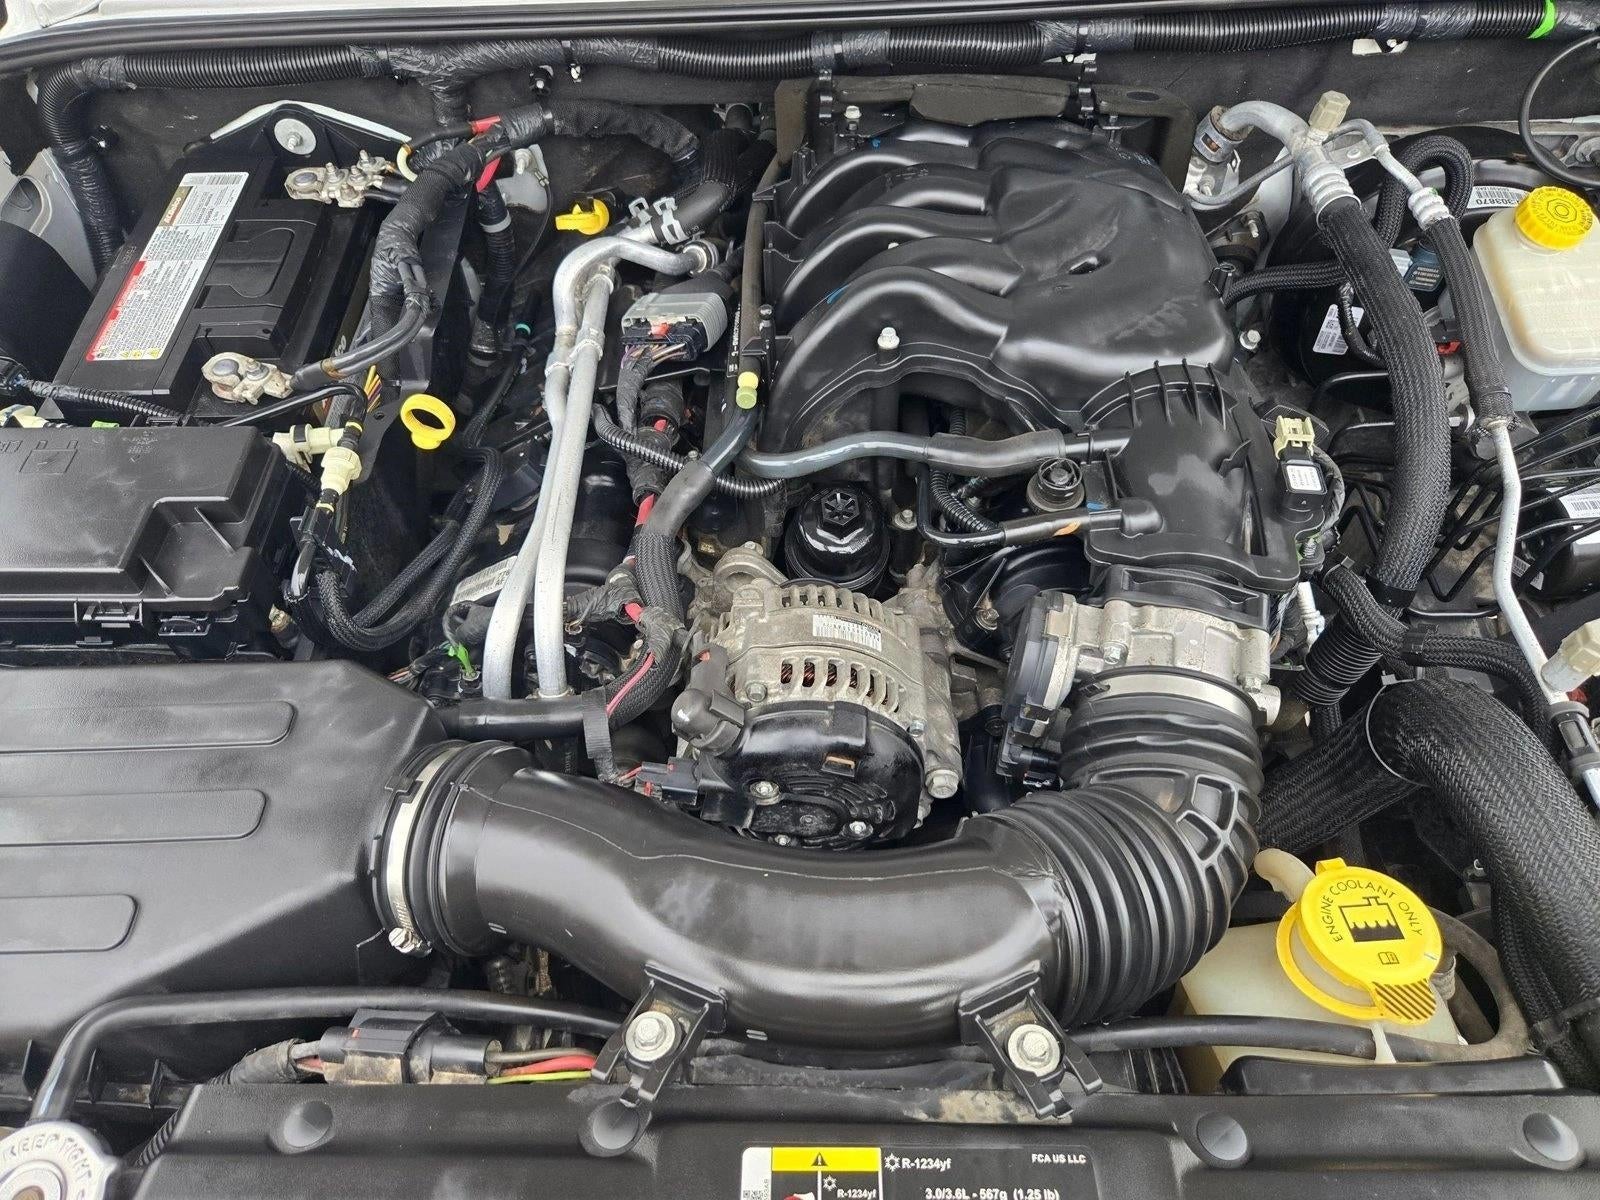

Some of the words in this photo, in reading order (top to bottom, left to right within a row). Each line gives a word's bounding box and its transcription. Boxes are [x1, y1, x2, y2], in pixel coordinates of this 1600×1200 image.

[163, 197, 182, 224] ACDelco
[1329, 879, 1398, 899] COOLANT
[1321, 895, 1343, 942] ENGINE
[1398, 901, 1423, 936] ONLY
[901, 1157, 952, 1172] R-1234yf
[1031, 1153, 1051, 1164] FCA
[1052, 1153, 1067, 1164] US
[1067, 1153, 1087, 1164] LLC
[836, 1188, 877, 1200] R-1234yf
[924, 1187, 970, 1200] 3.0/3.6L
[1013, 1187, 1042, 1200] (1.25
[1043, 1187, 1060, 1200] lb)
